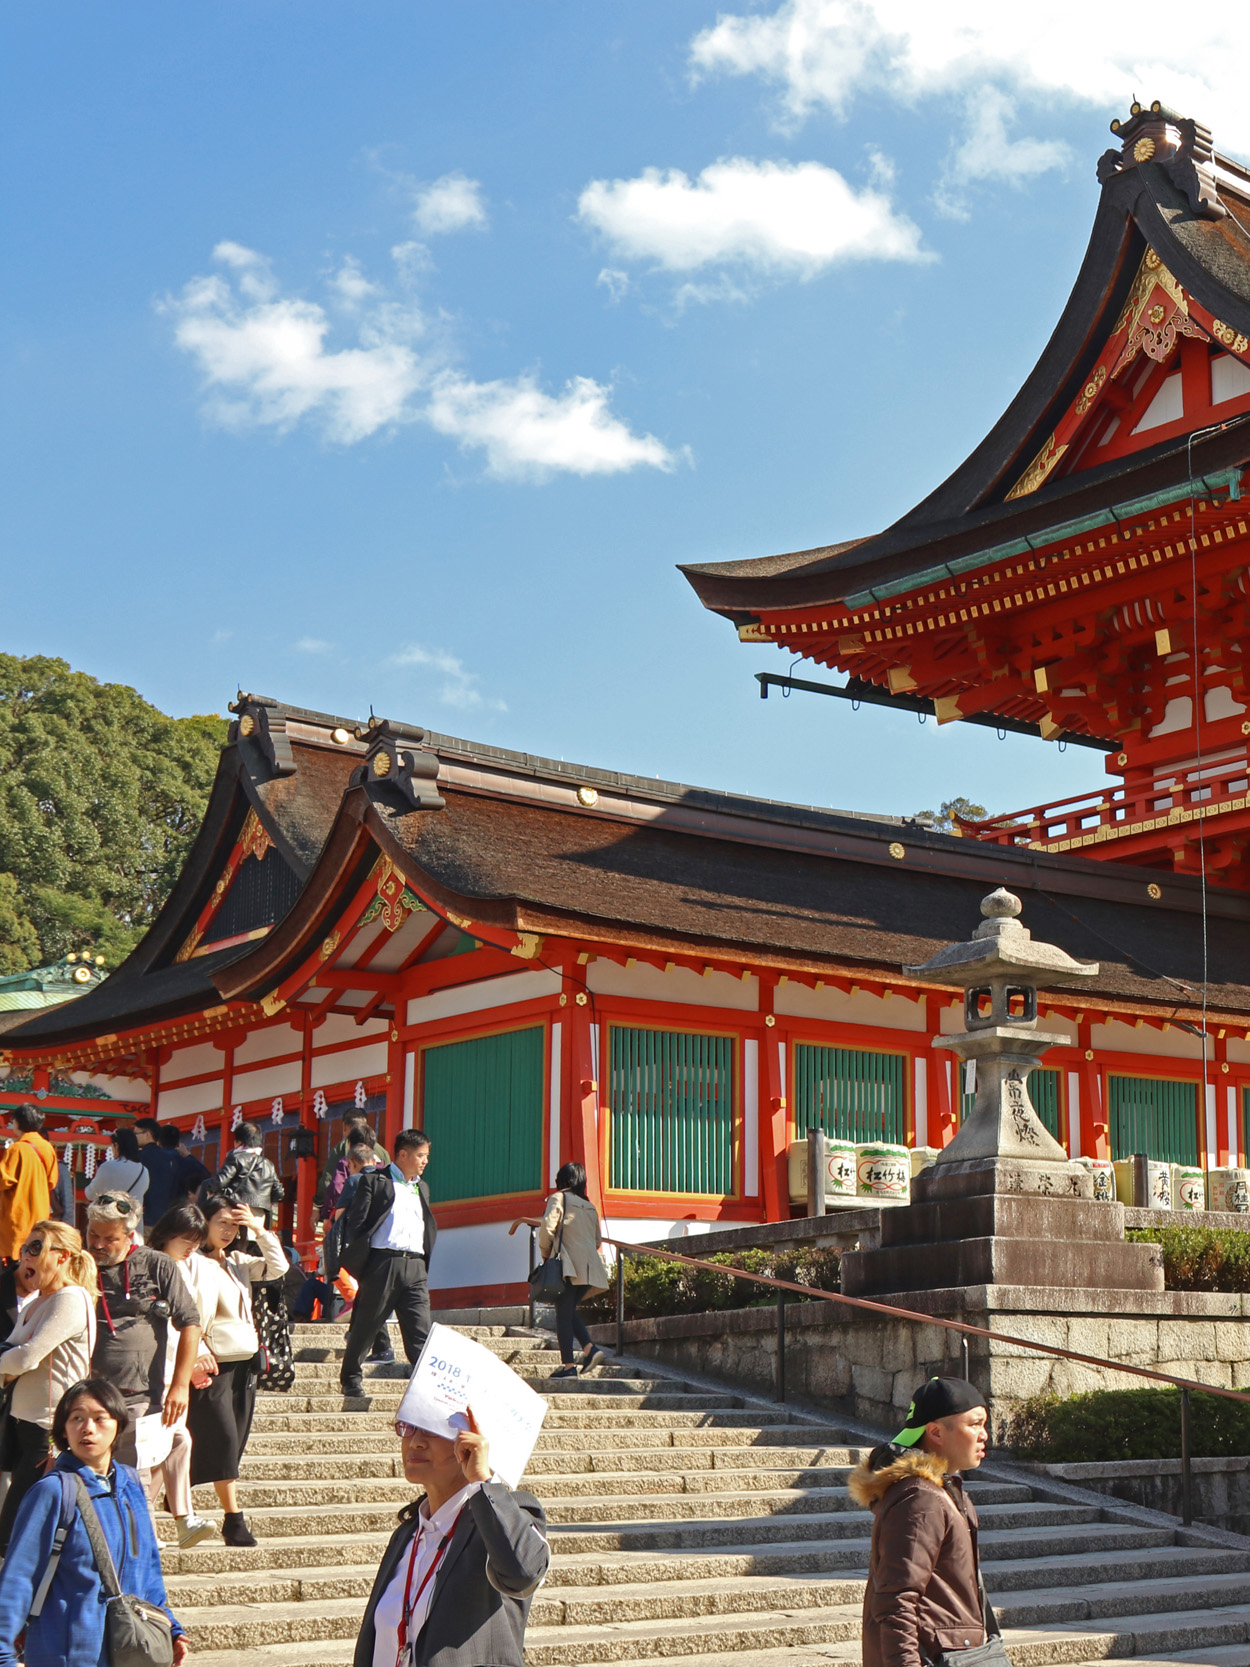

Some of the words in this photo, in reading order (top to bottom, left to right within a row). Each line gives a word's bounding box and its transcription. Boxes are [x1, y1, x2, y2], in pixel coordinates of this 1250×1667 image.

[866, 1166, 906, 1182] 松竹梅
[428, 1356, 462, 1378] 2018
